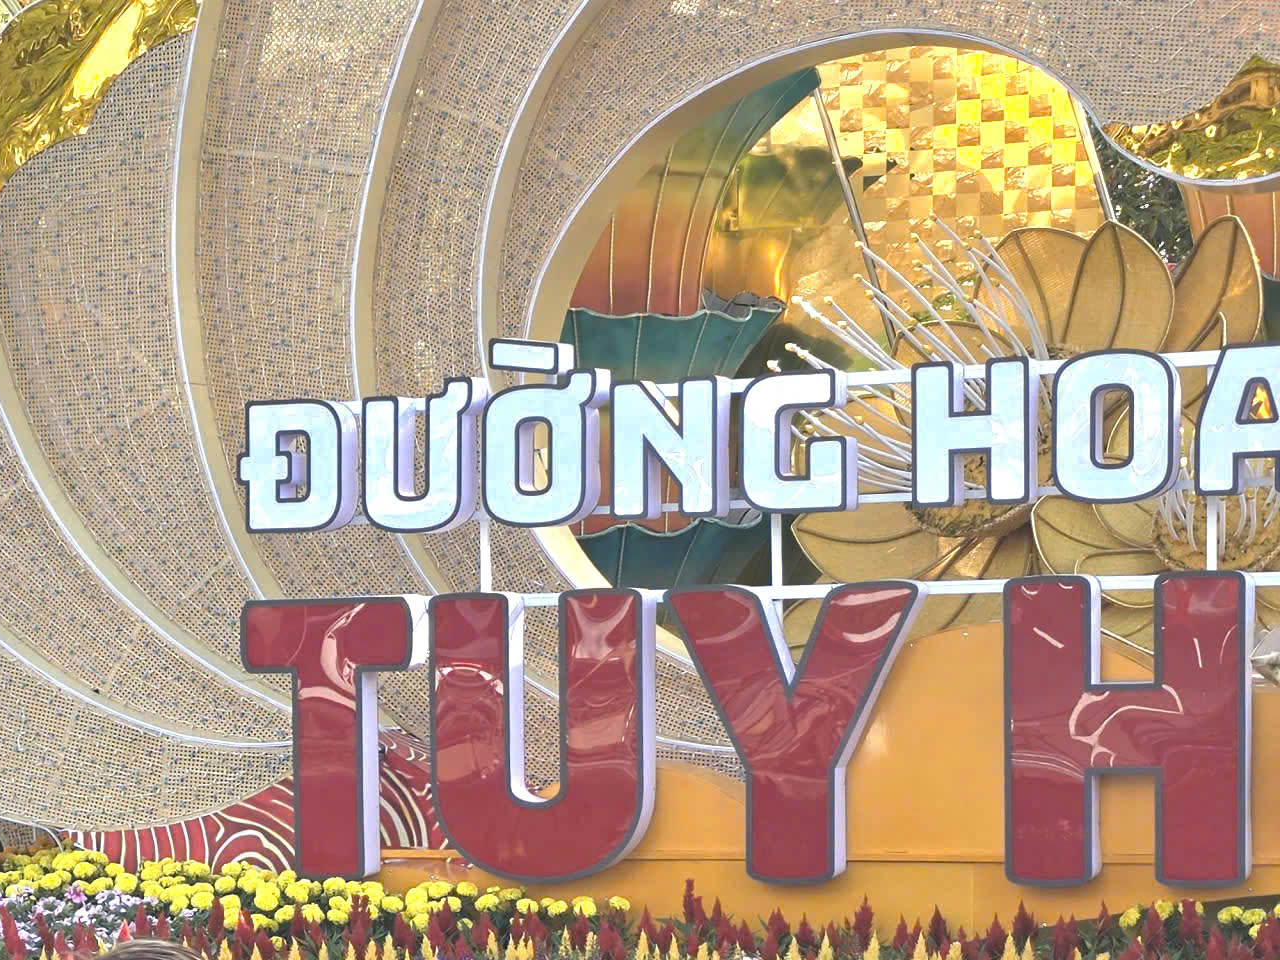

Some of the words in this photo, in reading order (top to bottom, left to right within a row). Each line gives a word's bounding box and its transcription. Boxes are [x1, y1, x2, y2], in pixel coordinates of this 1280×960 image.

[240, 338, 858, 534] ĐƯỜNG
[911, 343, 1280, 506] HOA
[240, 582, 924, 886] TUY
